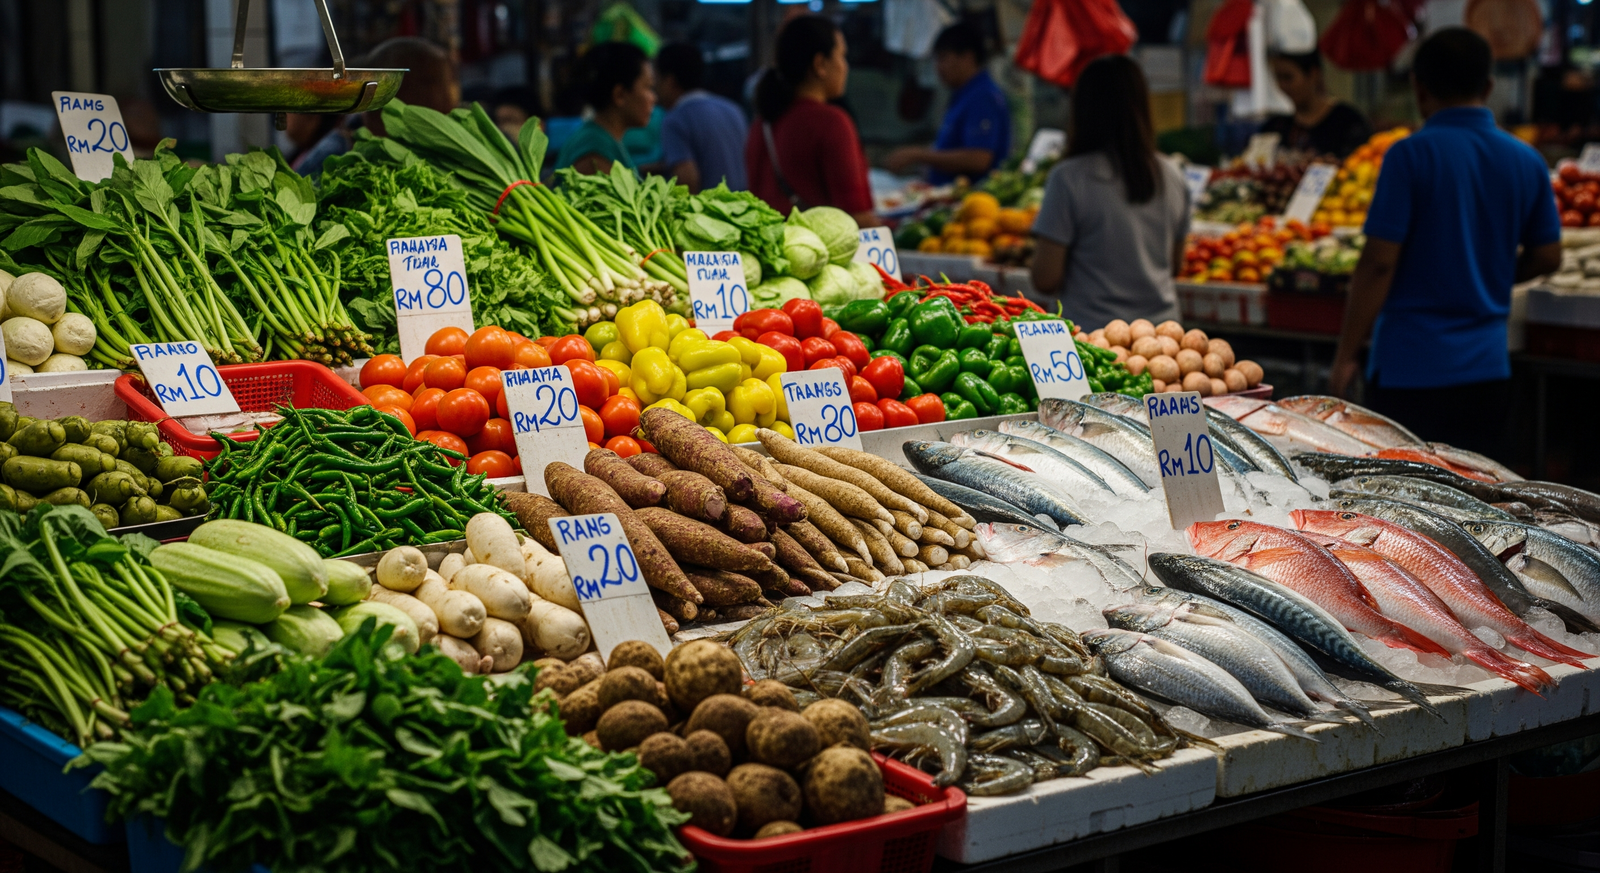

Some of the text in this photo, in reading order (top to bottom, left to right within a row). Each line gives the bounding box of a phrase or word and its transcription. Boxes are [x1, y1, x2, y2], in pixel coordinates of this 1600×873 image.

[67, 118, 128, 154] RM20
[395, 268, 465, 310] RM80
[693, 283, 748, 319] RM10
[155, 363, 222, 403] RM10
[1031, 350, 1083, 384] RM50
[514, 384, 578, 433] RM20
[1158, 432, 1214, 477] RM10
[573, 543, 638, 600] RM20
